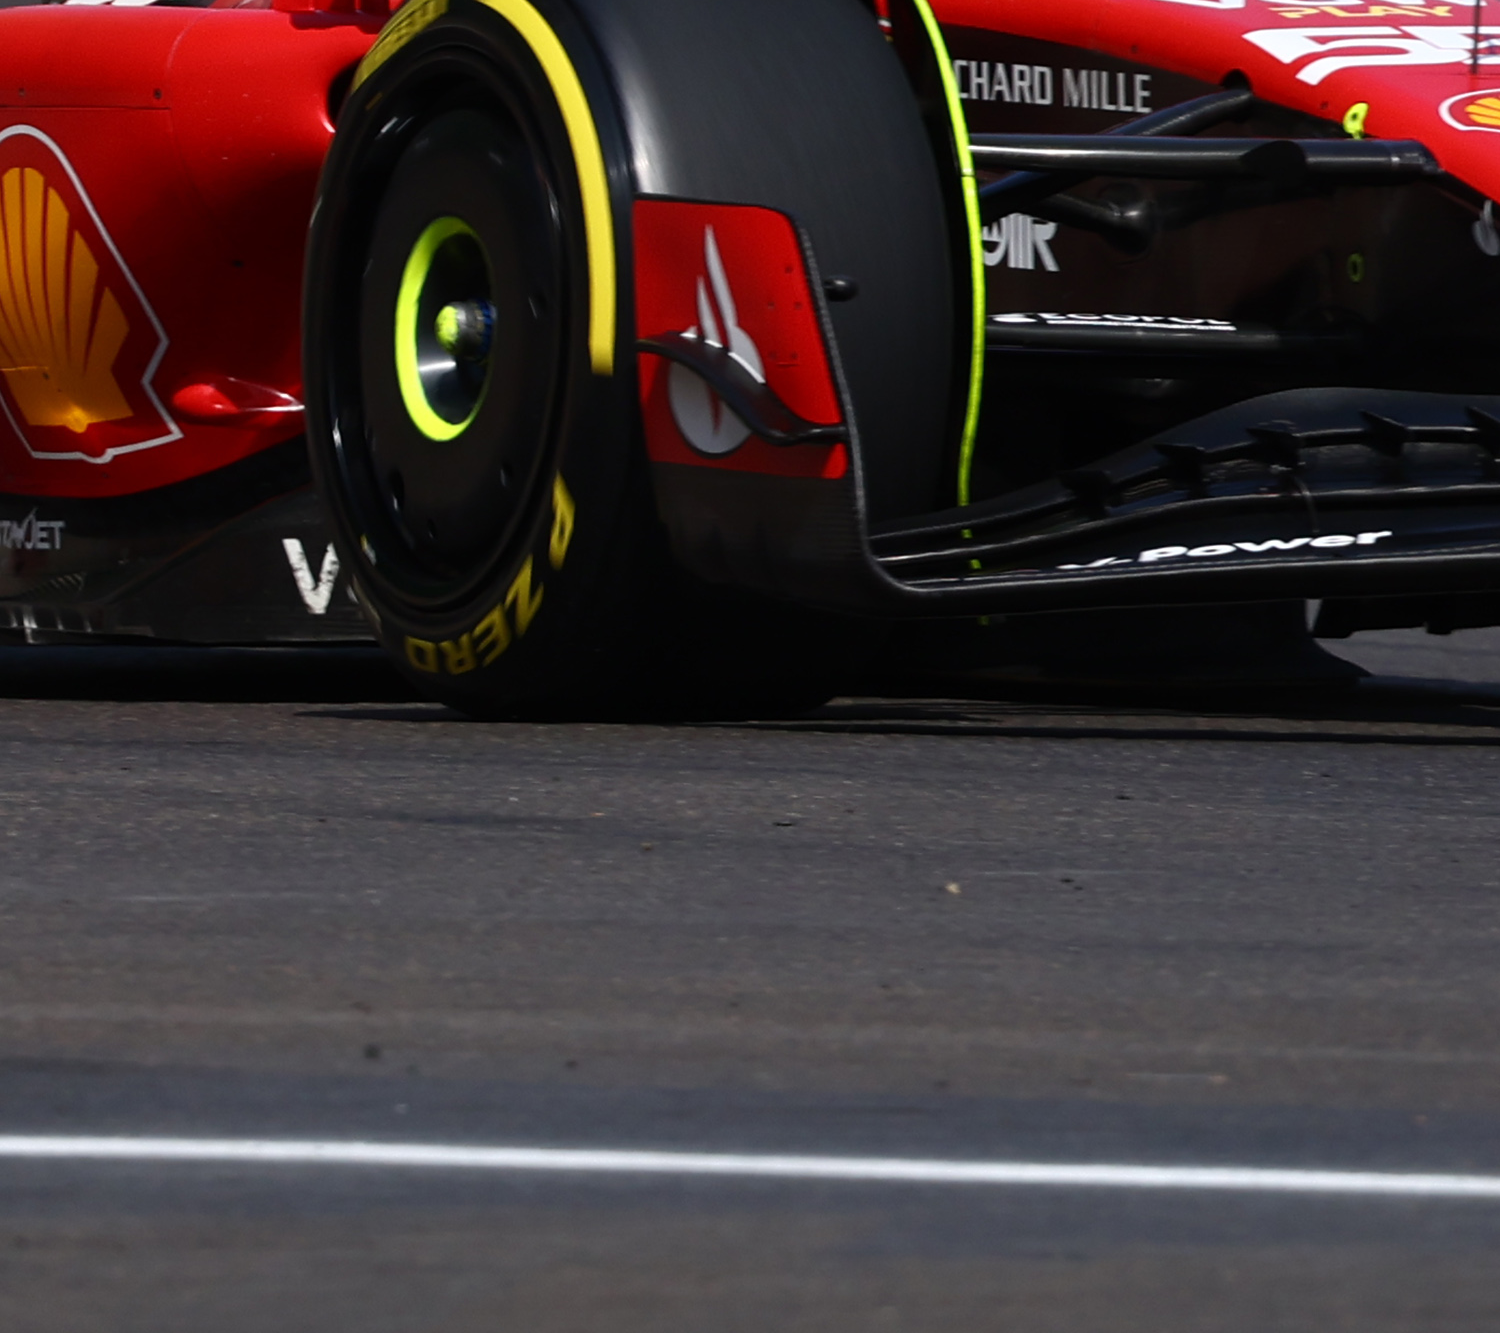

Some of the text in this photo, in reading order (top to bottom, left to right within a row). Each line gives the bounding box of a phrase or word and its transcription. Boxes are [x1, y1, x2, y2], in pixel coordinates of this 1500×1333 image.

[1268, 5, 1453, 19] PLAY
[953, 59, 1152, 114] CHARD MILLE
[1056, 530, 1393, 570] V-Power
